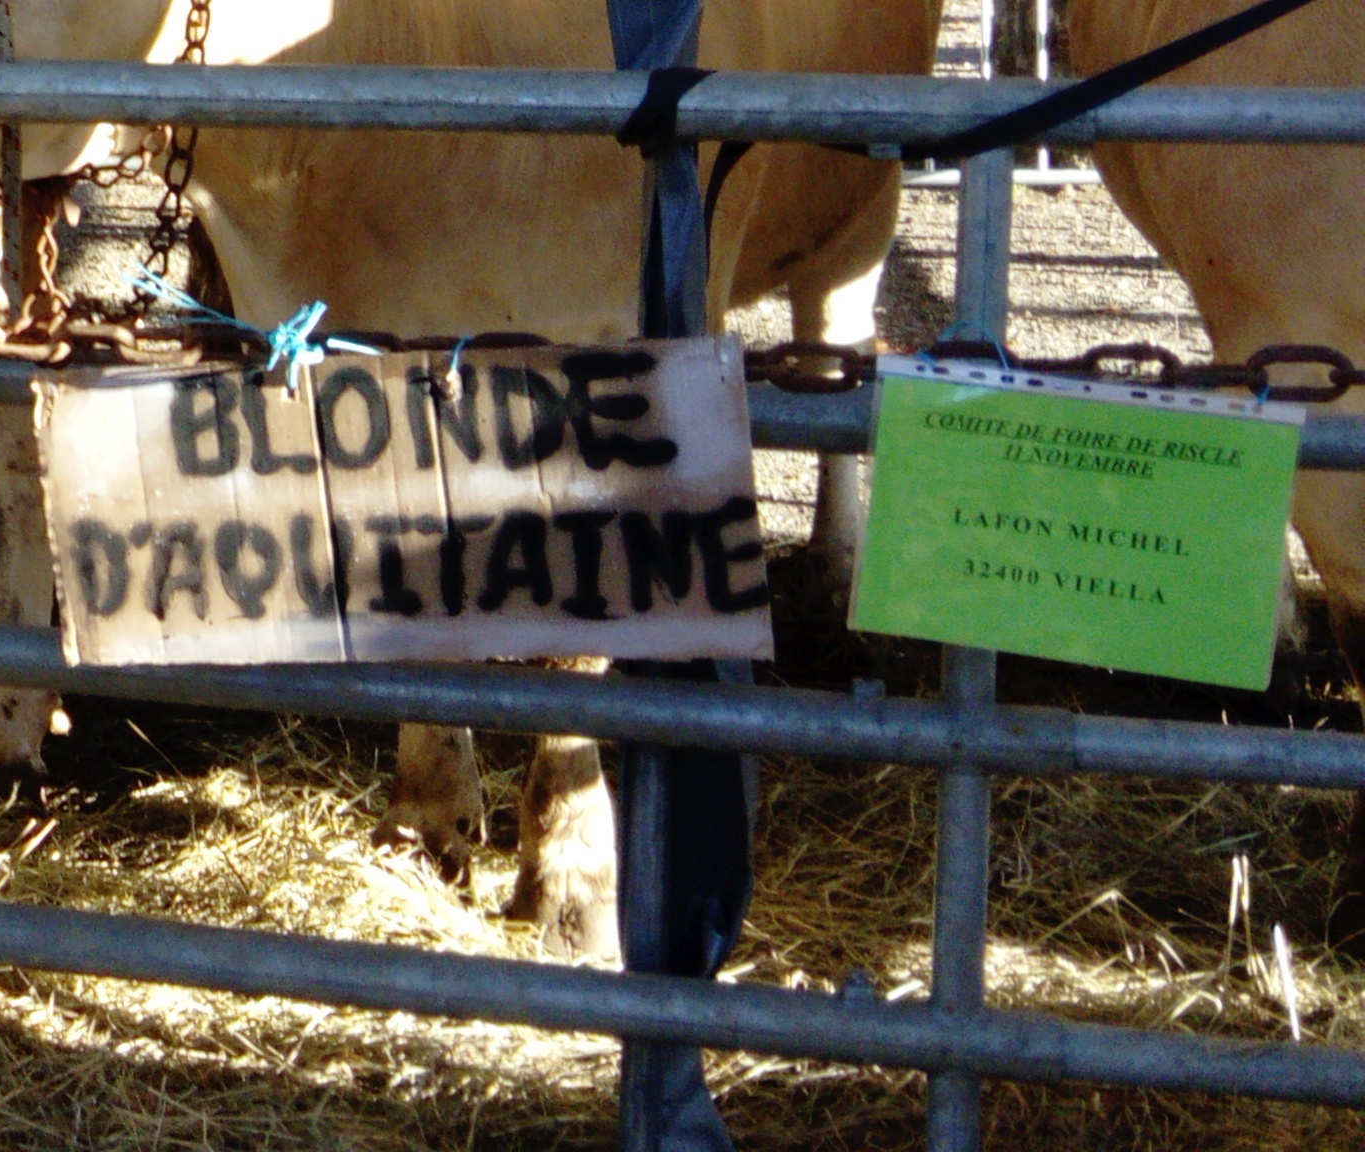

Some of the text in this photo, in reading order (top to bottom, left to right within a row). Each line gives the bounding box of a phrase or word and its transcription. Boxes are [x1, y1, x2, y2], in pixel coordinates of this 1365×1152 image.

[173, 352, 678, 476] BLONDE
[924, 411, 1245, 468] COMITE DE FOIRE DE RISCLE
[1026, 445, 1155, 479] NOVEMBRE
[73, 497, 769, 619] D'AQUITAINE
[953, 508, 1189, 557] LAFON MICHEL
[963, 559, 1166, 605] 32400 VIELLA
